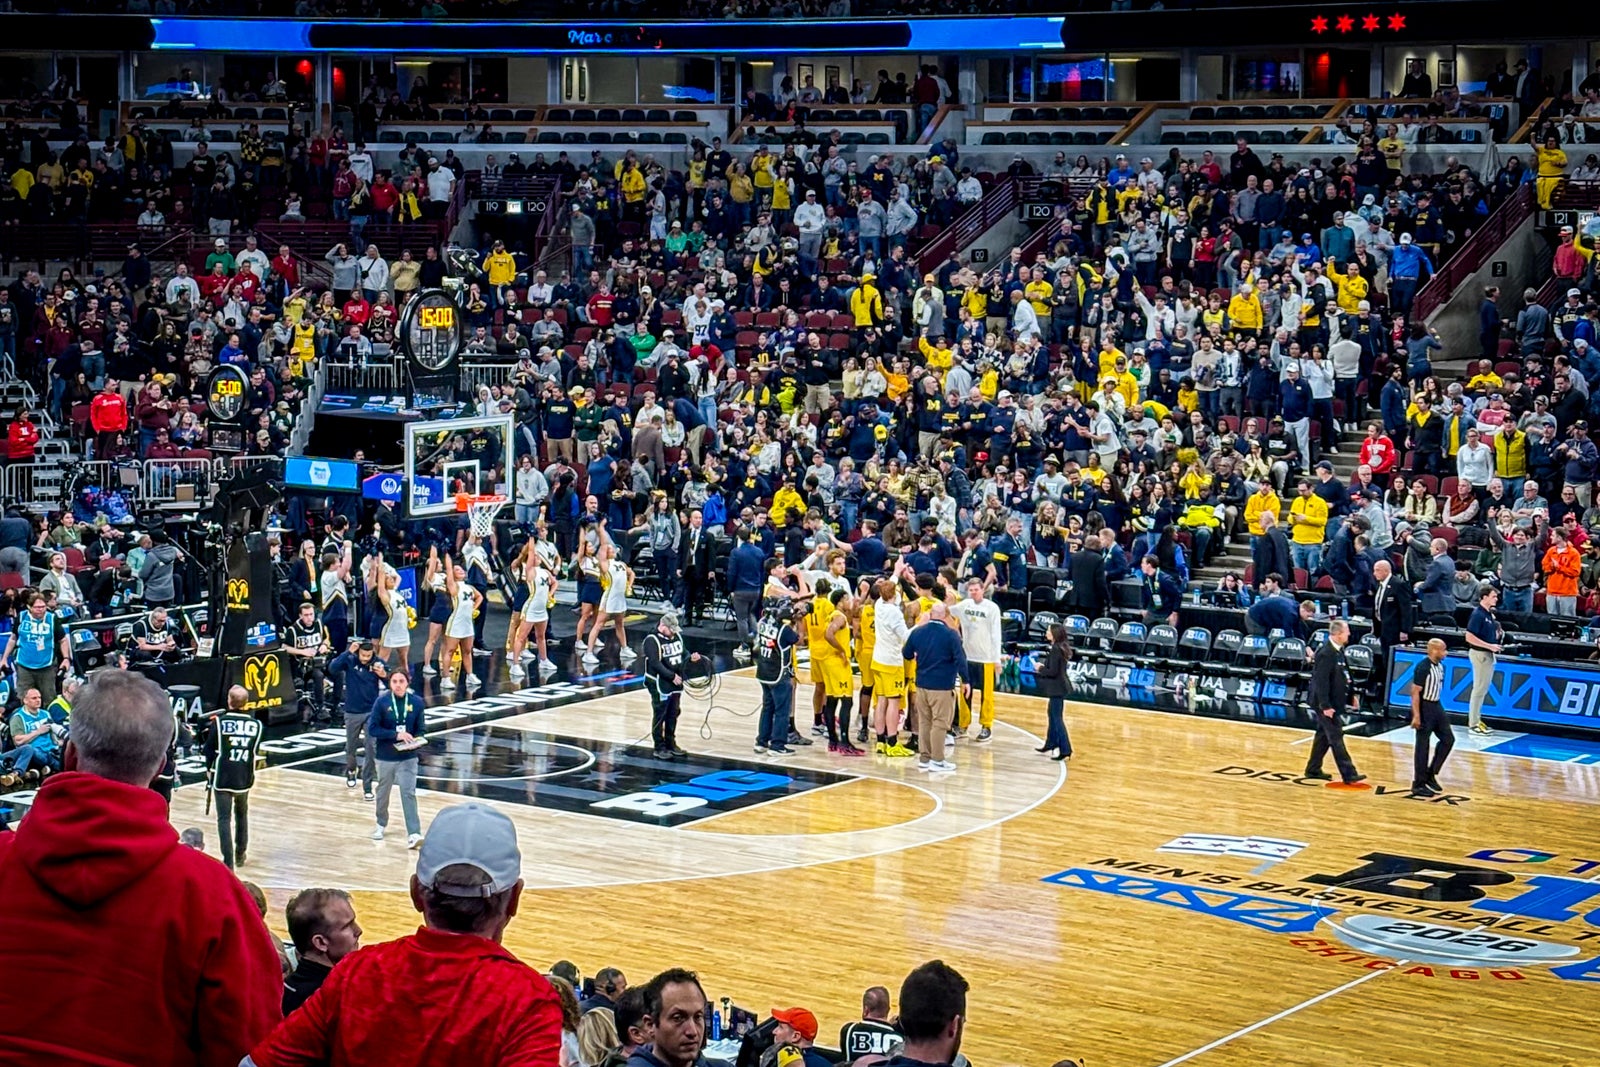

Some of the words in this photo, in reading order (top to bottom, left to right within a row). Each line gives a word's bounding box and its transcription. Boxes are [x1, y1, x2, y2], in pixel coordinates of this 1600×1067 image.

[485, 201, 499, 212] 119
[527, 201, 546, 212] 120
[1032, 206, 1051, 217] 120
[1554, 212, 1568, 225] 121
[421, 307, 453, 328] 15:00
[694, 324, 708, 336] 97
[757, 353, 769, 366] 10
[217, 380, 242, 395] 15:00
[926, 399, 941, 411] M
[613, 564, 626, 572] M
[462, 591, 474, 601] M
[396, 599, 407, 609] M
[810, 613, 819, 626] 11
[839, 681, 848, 689] M
[244, 697, 282, 711] RAM
[228, 736, 251, 747] TV
[229, 749, 250, 762] 174
[1088, 857, 1242, 885] MEN'S
[1239, 881, 1555, 936] BASKETBALL
[1373, 921, 1539, 953] 2026
[1289, 938, 1527, 981] CHICAGO
